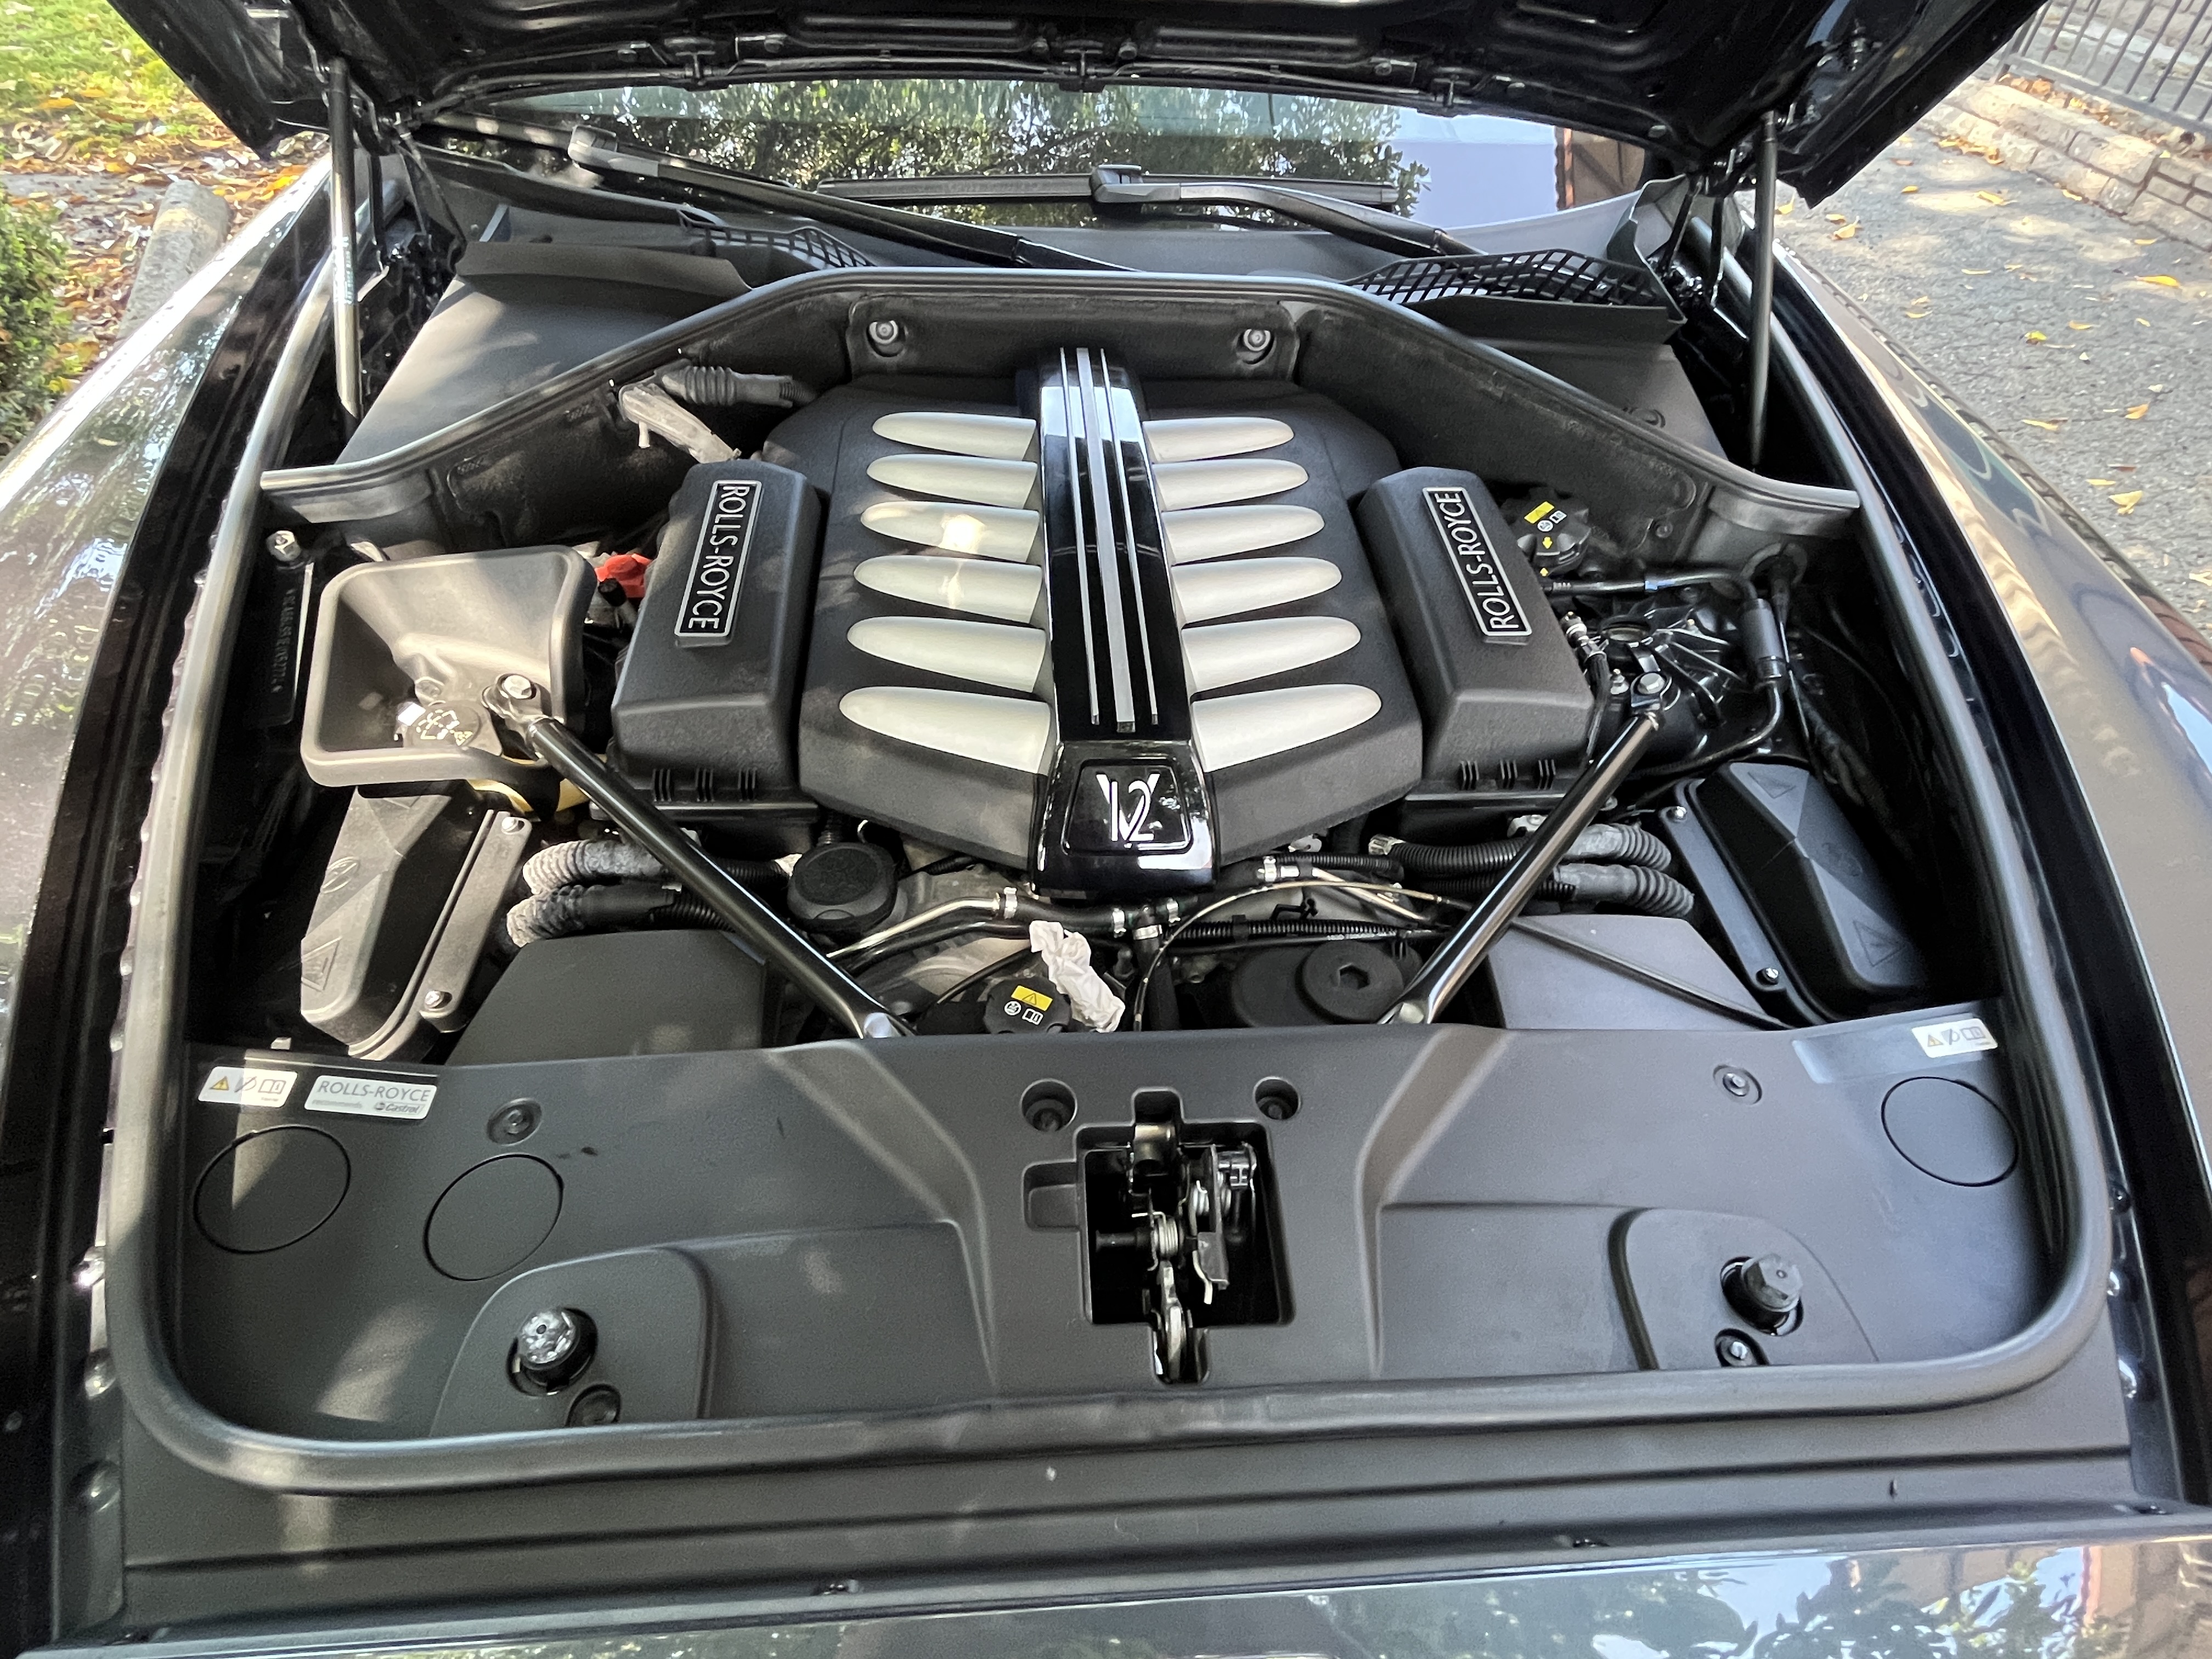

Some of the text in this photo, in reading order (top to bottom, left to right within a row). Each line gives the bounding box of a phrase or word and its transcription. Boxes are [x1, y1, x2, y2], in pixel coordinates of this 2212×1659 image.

[688, 486, 750, 629] ROLLS-ROYCE
[1434, 493, 1519, 629] ROLLS-ROYCE
[318, 1081, 431, 1102] ROLLS-ROYCE
[385, 1103, 420, 1114] Castrol
